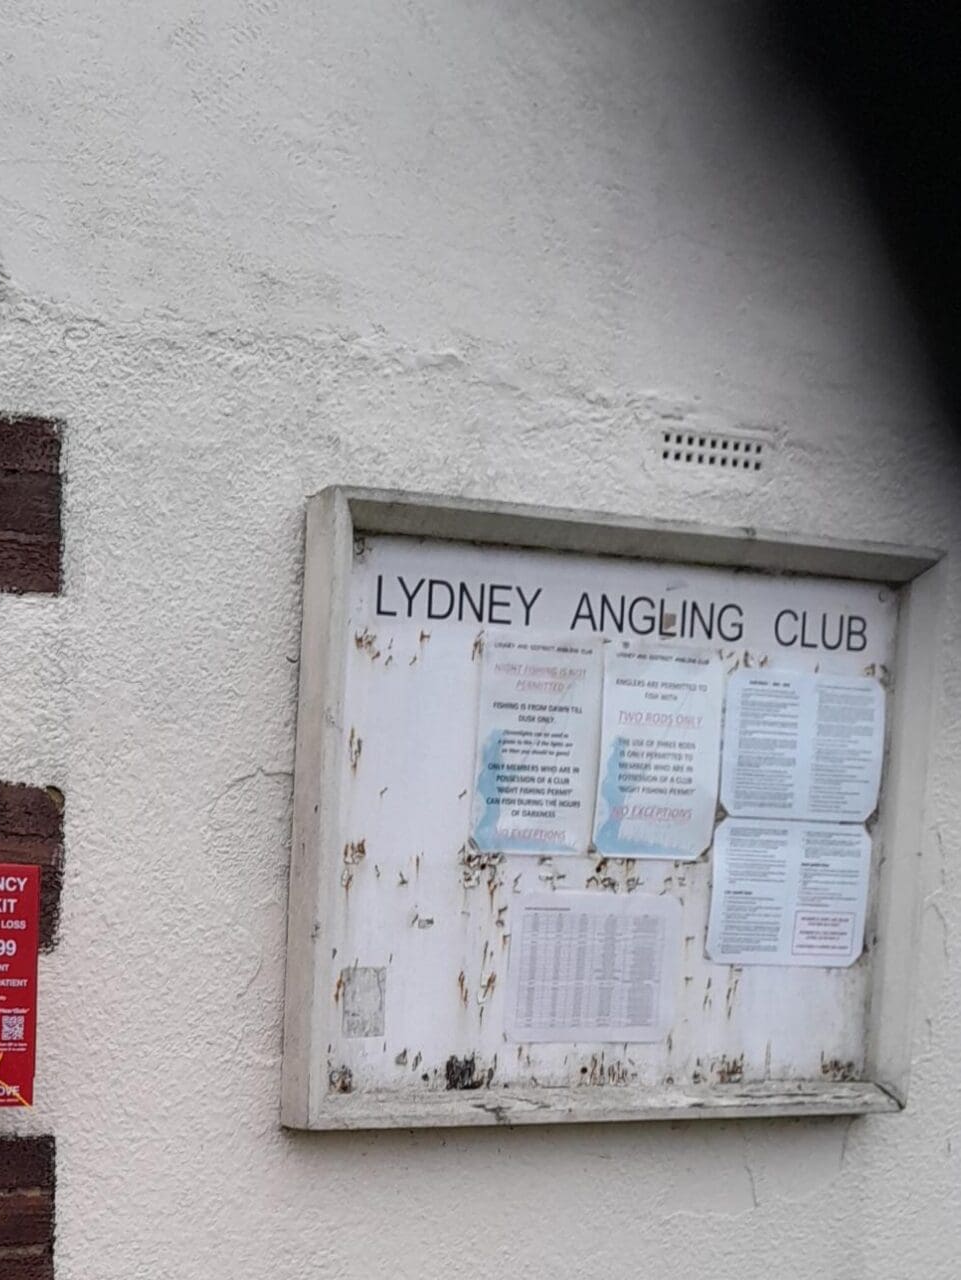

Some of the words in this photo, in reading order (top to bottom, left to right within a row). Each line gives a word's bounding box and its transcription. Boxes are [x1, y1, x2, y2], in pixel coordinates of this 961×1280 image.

[376, 574, 543, 626] LYDNEY
[570, 592, 744, 642] ANGLING
[774, 609, 868, 652] CLUB
[494, 663, 522, 674] NIGHT
[615, 678, 645, 688] ANGLERS
[646, 680, 659, 689] ARE
[660, 681, 697, 692] PERMITTED
[698, 684, 708, 692] TO
[493, 701, 519, 710] FISHING
[520, 702, 526, 711] IS
[527, 703, 547, 712] FROM
[548, 704, 569, 713] DAWN
[570, 706, 583, 714] TILL
[618, 710, 644, 724] TWO
[645, 711, 673, 726] RODS
[675, 713, 704, 728] ONLY
[631, 739, 644, 747] USE
[656, 740, 676, 748] THREE
[678, 741, 696, 750] RODS
[626, 750, 645, 759] ONLY
[645, 752, 682, 761] PERMITTED
[684, 753, 694, 762] TO
[487, 762, 505, 772] ONLY
[506, 763, 539, 772] MEMBERS
[540, 765, 557, 773] WHO
[558, 765, 571, 774] ARE
[572, 766, 580, 774] IN
[618, 761, 651, 771] MEMBERS
[653, 763, 671, 772] WHO
[672, 764, 684, 772] ARE
[496, 774, 536, 784] POSSESSION
[536, 776, 546, 784] OF
[553, 777, 570, 785] CLUB
[519, 787, 545, 795] FISHING
[486, 797, 500, 805] CAN
[501, 797, 516, 806] FISH
[517, 798, 544, 807] DURING
[545, 799, 557, 807] THE
[558, 800, 581, 808] HOURS
[511, 809, 520, 818] OF
[521, 810, 556, 818] DARKNESS
[613, 806, 629, 818] NO
[631, 806, 693, 820] EXCEPTIONS
[510, 828, 567, 841] EXCEPTIONS
[0, 919, 27, 930] LOSS
